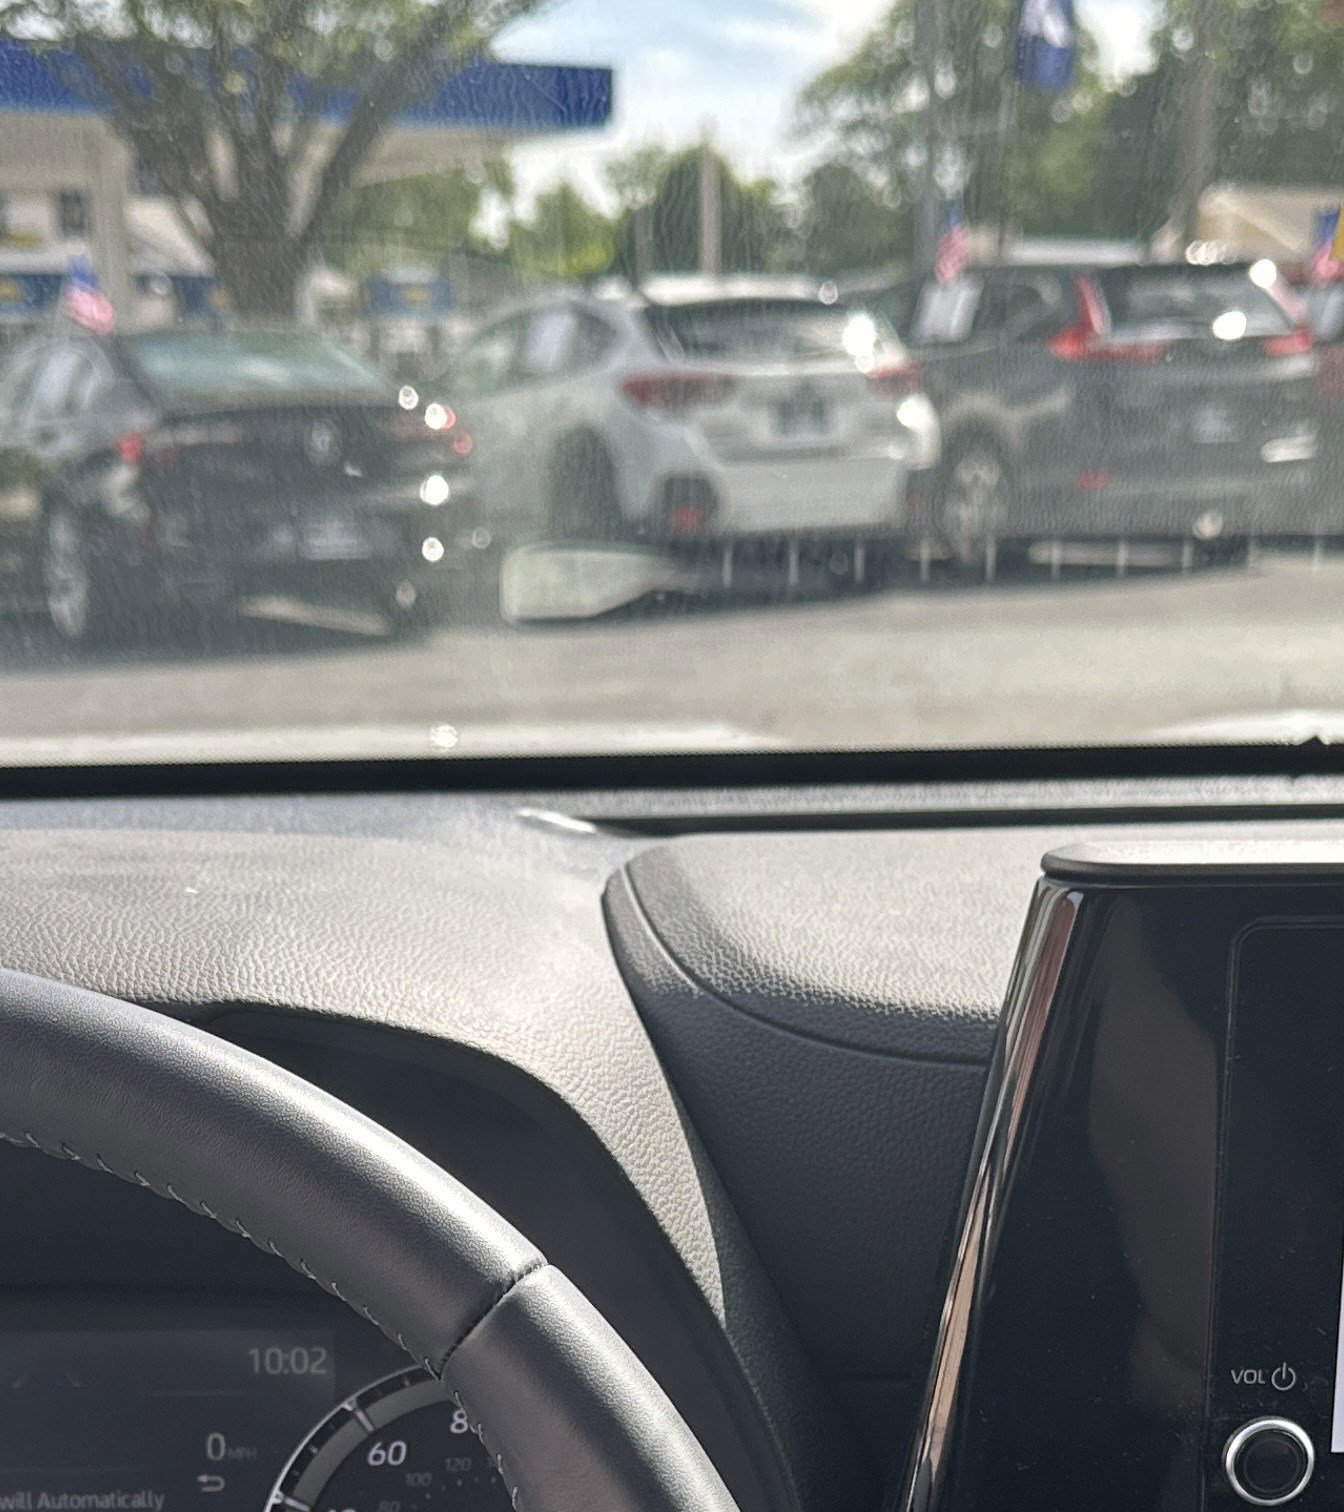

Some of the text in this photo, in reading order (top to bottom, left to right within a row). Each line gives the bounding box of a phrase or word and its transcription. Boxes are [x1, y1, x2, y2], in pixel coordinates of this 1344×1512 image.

[248, 1347, 328, 1375] 10:02
[1231, 1369, 1266, 1384] VOL
[205, 1432, 226, 1462] 0
[367, 1440, 407, 1466] 60
[405, 1472, 432, 1487] 100
[0, 1490, 33, 1511] will
[36, 1489, 165, 1512] Automatically
